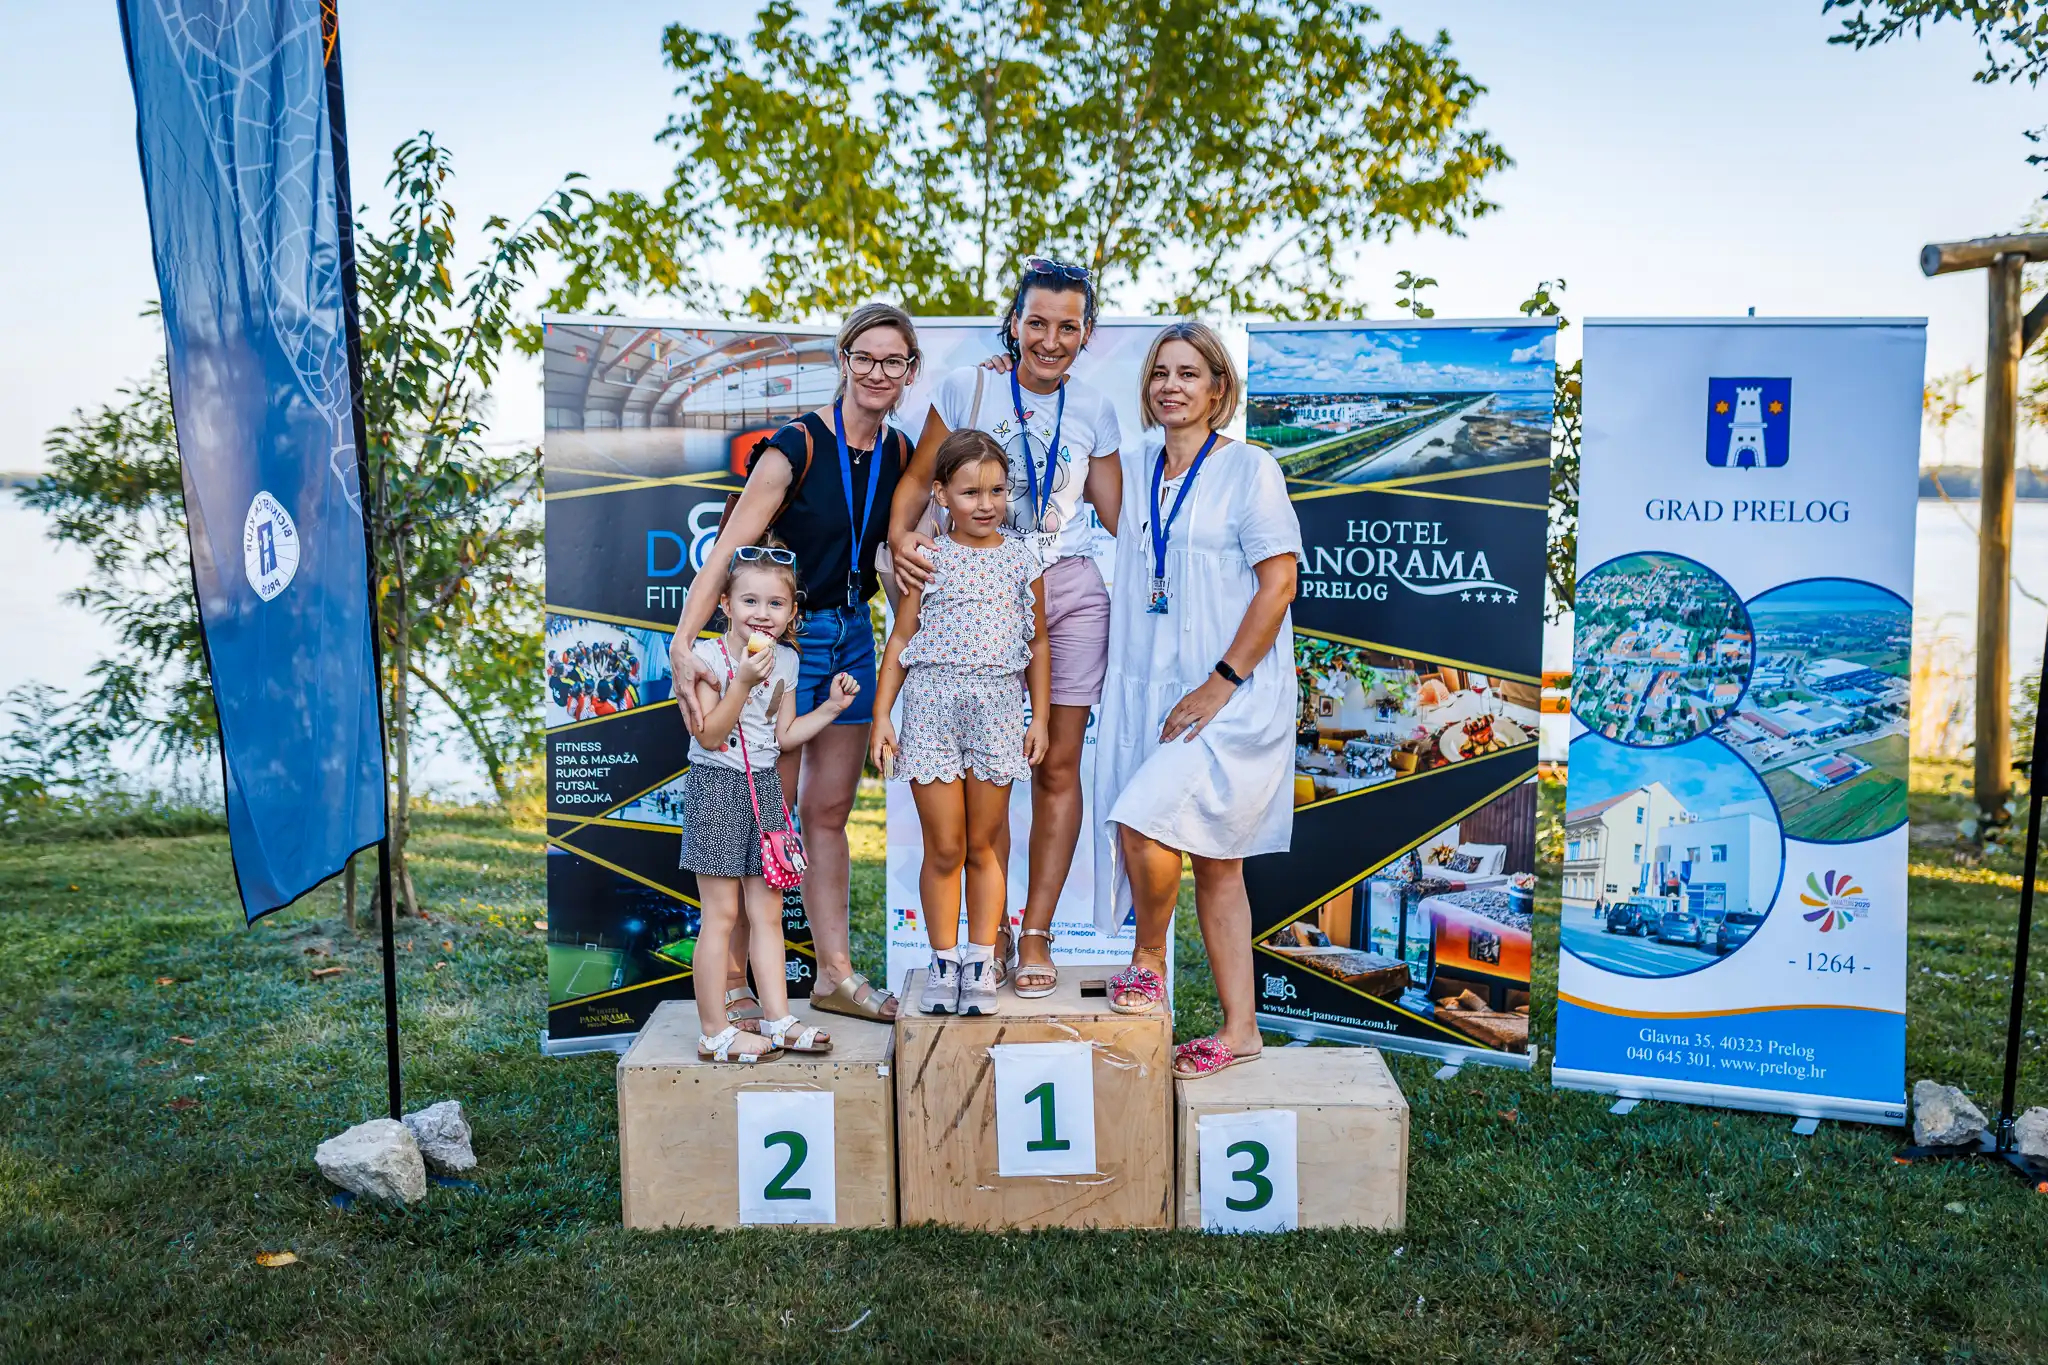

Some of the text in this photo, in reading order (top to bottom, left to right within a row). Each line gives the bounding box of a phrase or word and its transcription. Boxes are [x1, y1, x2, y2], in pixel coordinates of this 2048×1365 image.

[1645, 499, 1850, 523] GRAD PRELOG
[1346, 520, 1448, 545] HOTEL
[1301, 580, 1388, 601] PRELOG
[555, 742, 602, 752] FITNESS
[555, 752, 639, 765] SPA & MASAŽA
[555, 767, 611, 778] RUKOMET
[555, 781, 599, 791] FUTSAL
[555, 793, 613, 804] ODBOJKA
[892, 940, 927, 949] Projekt je
[1074, 946, 1095, 954] fonda
[1807, 952, 1856, 974] 1264
[1262, 1003, 1399, 1031] www.hotel-panorama.com.hr
[1639, 1028, 1815, 1061] Glavna 35, 40323 Prelog
[1626, 1046, 1827, 1080] 040 645 301, www.prelog.hr
[1024, 1082, 1070, 1152] 1
[763, 1130, 811, 1200] 2
[1225, 1140, 1274, 1212] 3
